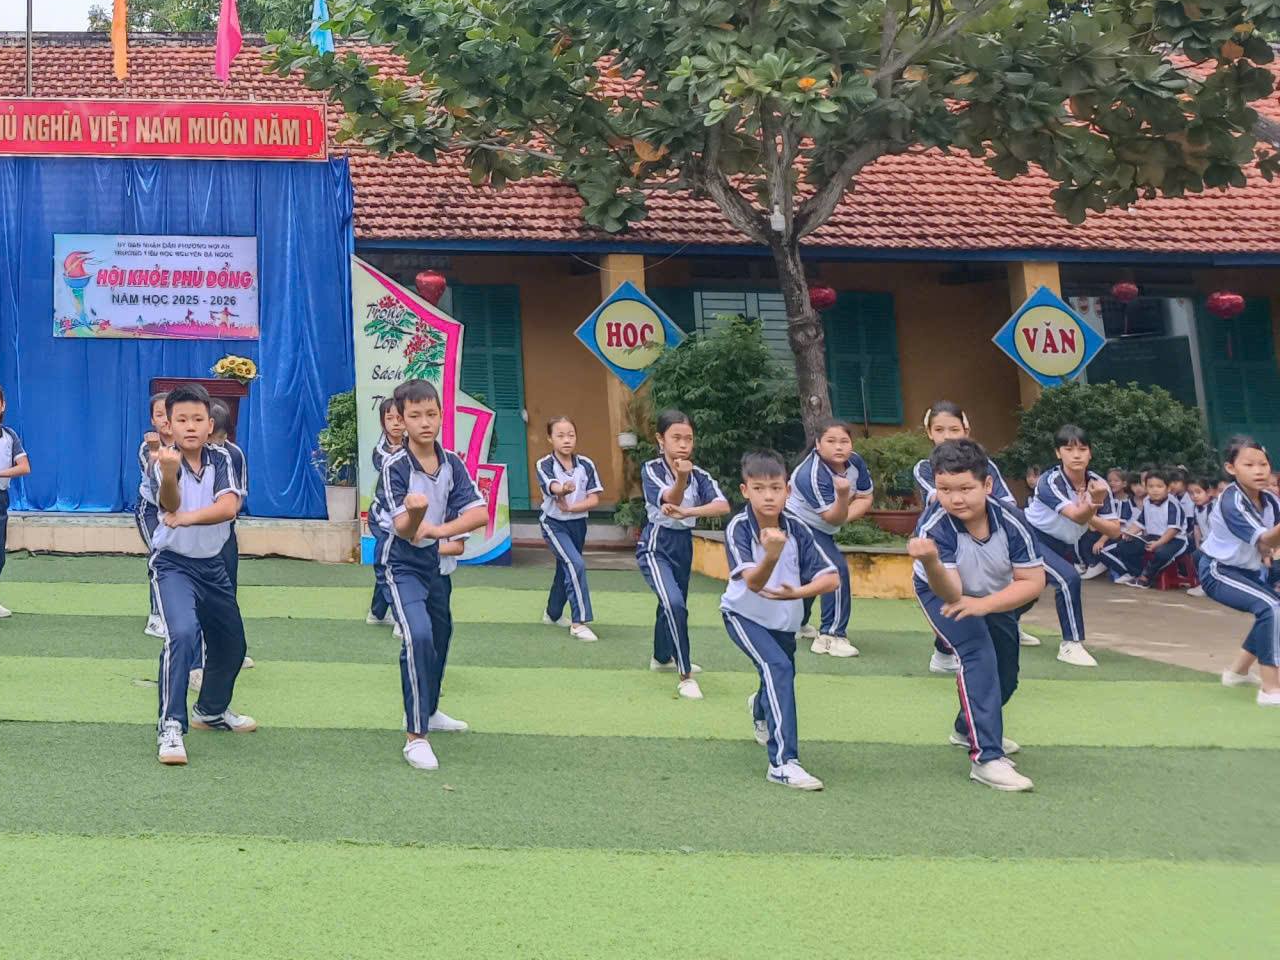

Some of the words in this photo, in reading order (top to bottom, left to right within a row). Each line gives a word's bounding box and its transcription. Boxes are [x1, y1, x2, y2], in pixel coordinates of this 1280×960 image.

[22, 110, 83, 142] NGHĨA
[88, 110, 129, 148] VIỆT
[136, 116, 182, 144] NAM
[188, 112, 248, 145] MUÔN
[253, 113, 300, 146] NĂM
[96, 265, 126, 292] HỘI
[127, 264, 170, 288] KHỎE
[112, 293, 139, 304] NĂM
[142, 295, 169, 307] HỌC
[172, 295, 199, 305] 2025
[210, 296, 237, 306] 2026
[367, 303, 405, 323] Trong
[1022, 321, 1076, 354] VĂN
[371, 365, 402, 380] Sách
